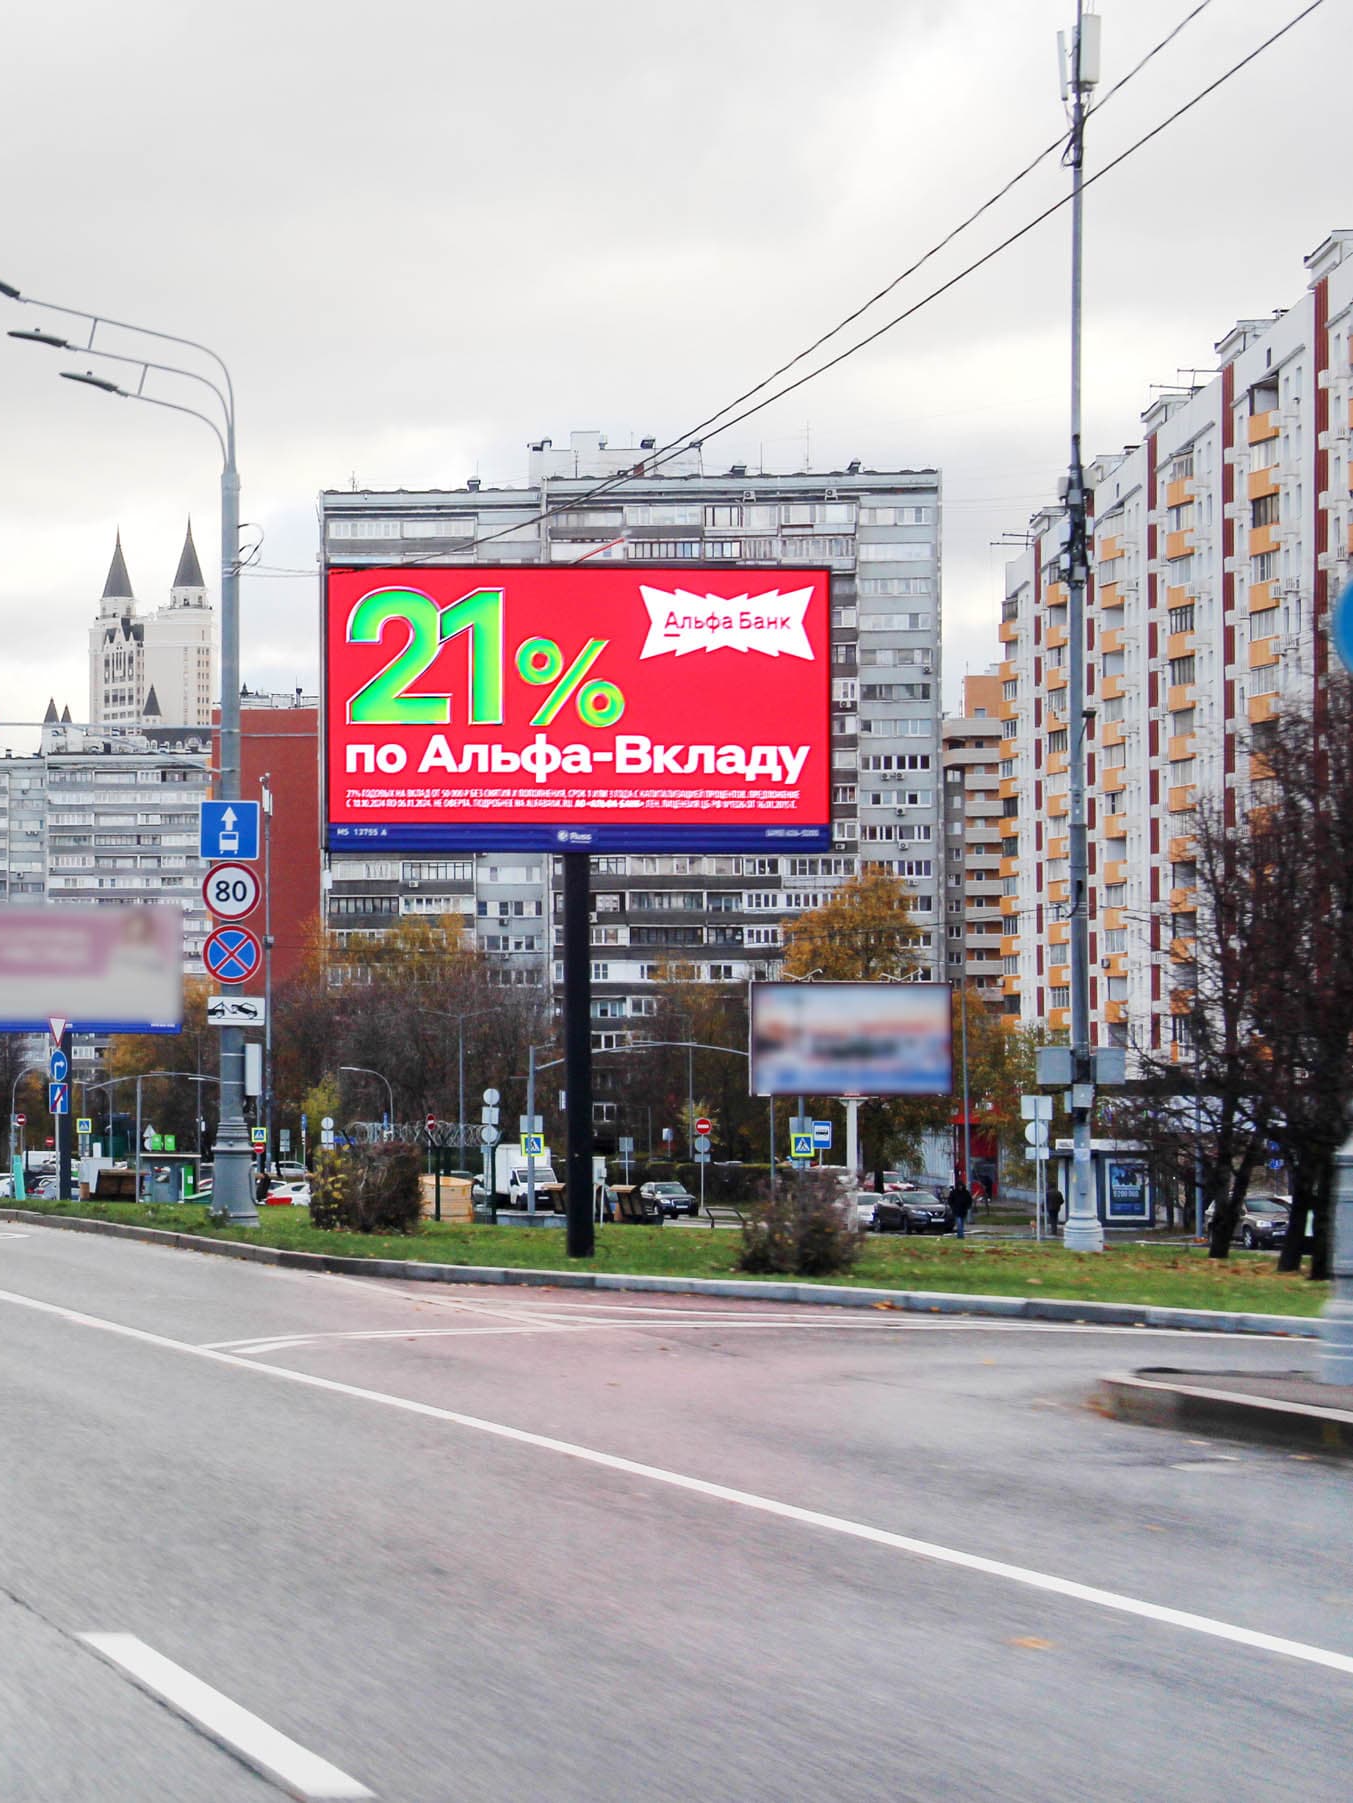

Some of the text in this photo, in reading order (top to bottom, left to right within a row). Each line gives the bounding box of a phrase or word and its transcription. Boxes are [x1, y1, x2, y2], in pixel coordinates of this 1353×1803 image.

[664, 611, 792, 634] Альфа Банк
[346, 586, 626, 728] 21%
[346, 733, 811, 785] по Альфа-Вкладу
[216, 880, 247, 902] 80
